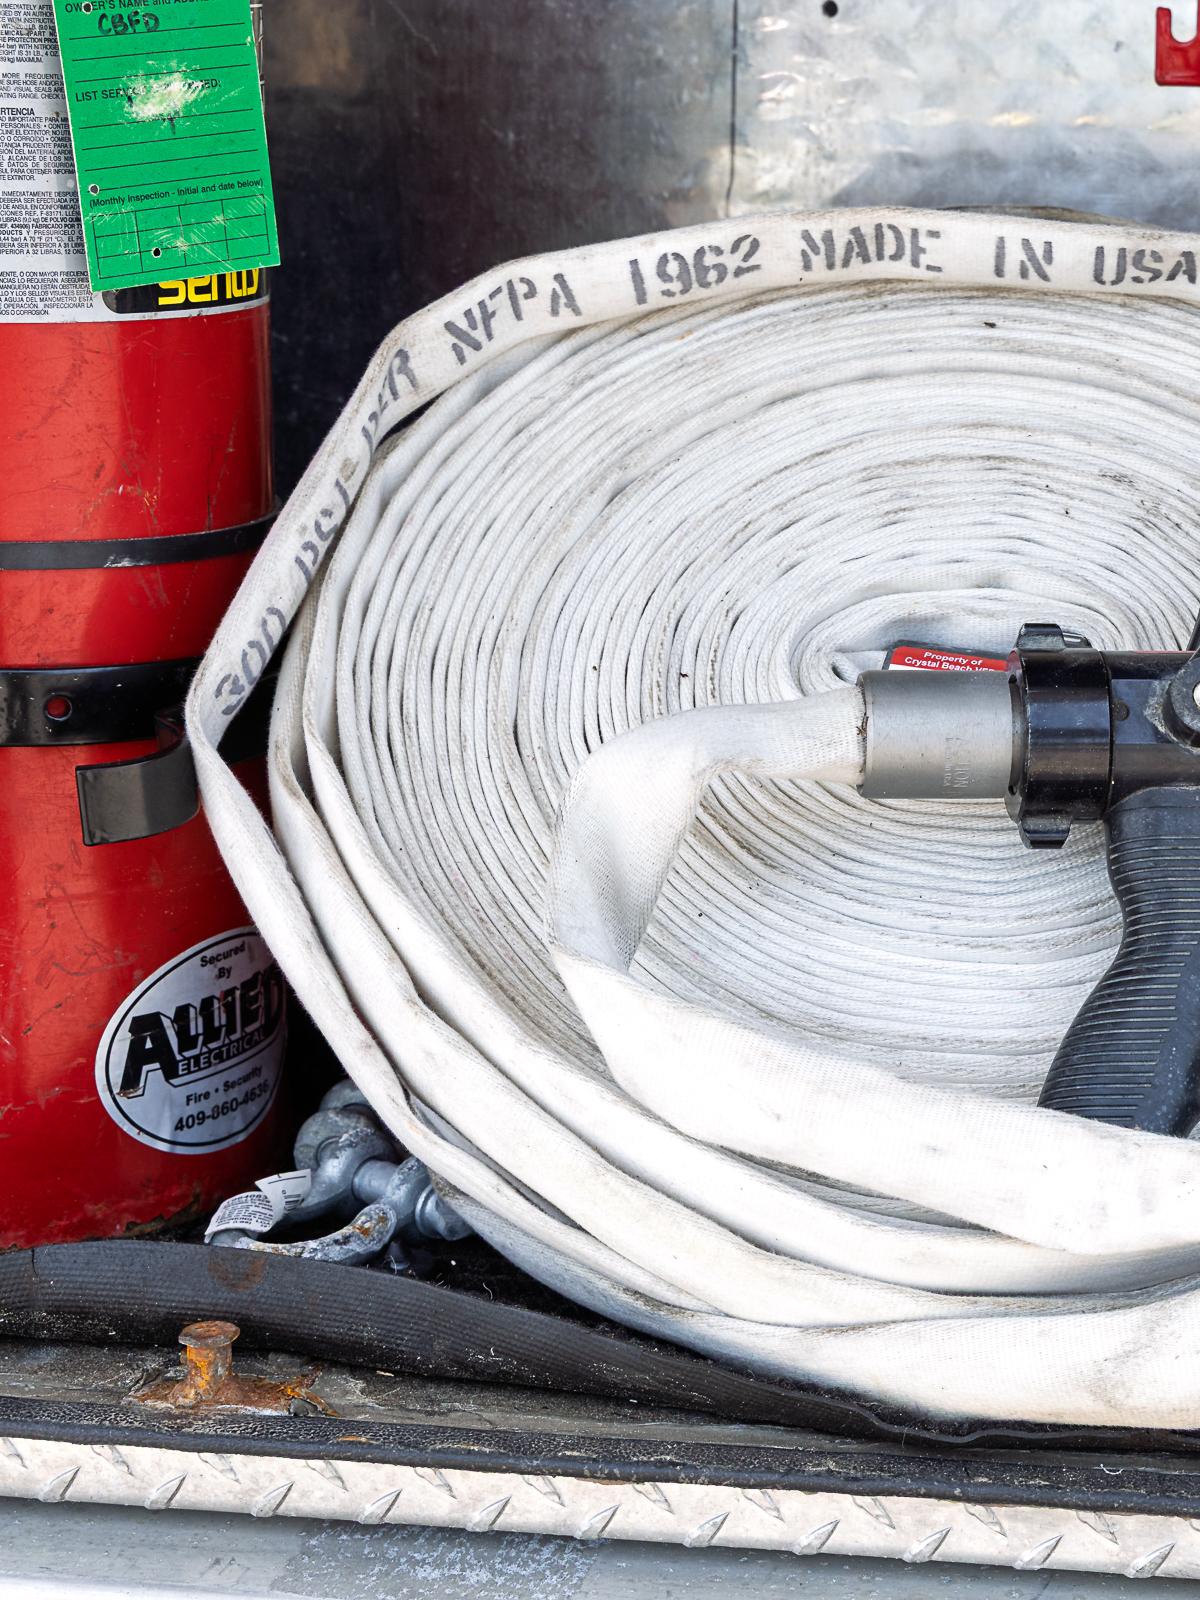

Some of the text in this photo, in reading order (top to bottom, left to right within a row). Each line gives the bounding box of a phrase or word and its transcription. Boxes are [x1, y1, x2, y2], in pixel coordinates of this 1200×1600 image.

[65, 0, 115, 13] OWER'S
[97, 10, 160, 35] CBFD
[75, 90, 98, 102] LIST
[90, 178, 263, 208] (Monthly Inspection Initial and date below)
[444, 272, 582, 366] NFPA
[629, 233, 762, 305] 1962
[800, 221, 943, 273] MADE
[994, 235, 1053, 283] IN
[1093, 244, 1199, 287] USA
[904, 656, 940, 667] Crystal
[941, 662, 973, 671] Beach
[923, 651, 969, 665] Property
[200, 940, 246, 968] Secured
[217, 964, 233, 980] By
[178, 1029, 266, 1075] ELECTRICAL
[186, 1065, 263, 1106] Fire Security
